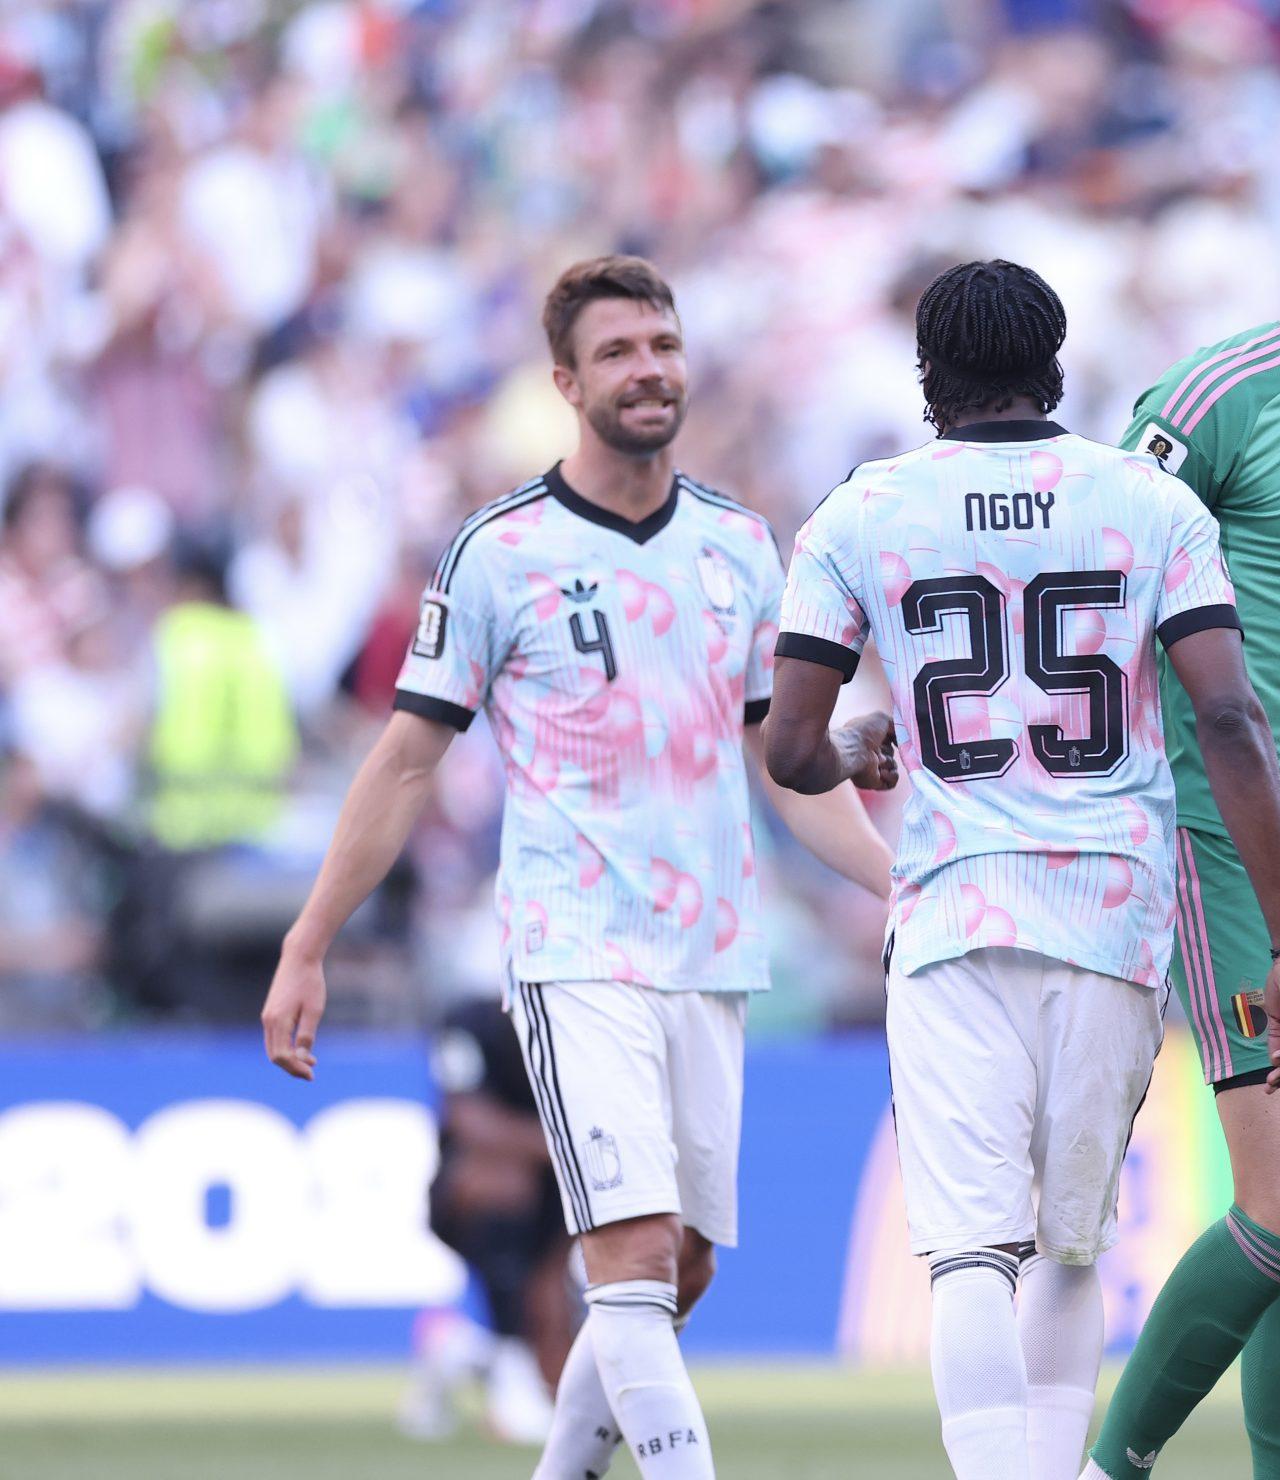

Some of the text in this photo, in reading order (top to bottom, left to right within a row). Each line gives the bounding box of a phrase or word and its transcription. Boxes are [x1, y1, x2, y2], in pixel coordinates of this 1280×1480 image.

[964, 491, 1055, 532] NGOY
[569, 609, 616, 683] 4
[901, 570, 1130, 783] 25
[637, 1429, 698, 1458] RBFA
